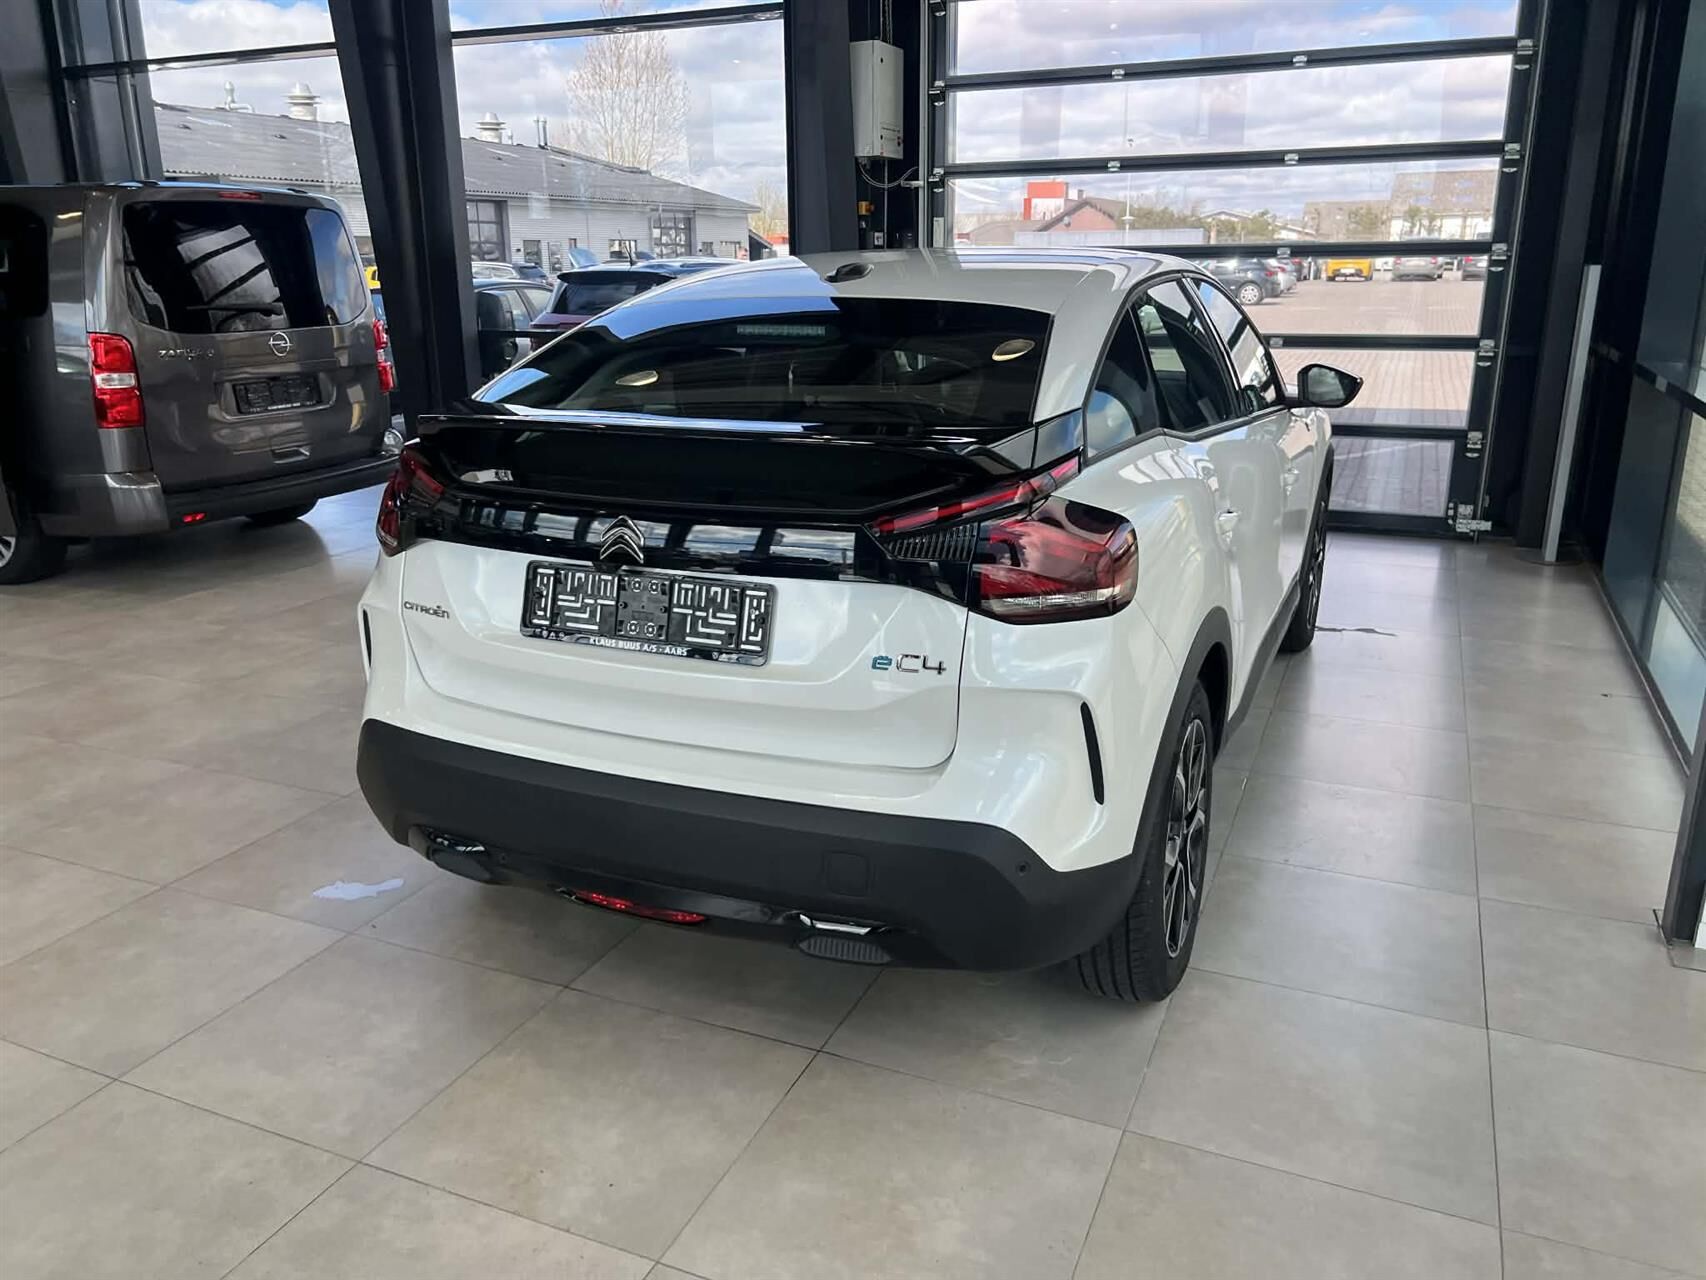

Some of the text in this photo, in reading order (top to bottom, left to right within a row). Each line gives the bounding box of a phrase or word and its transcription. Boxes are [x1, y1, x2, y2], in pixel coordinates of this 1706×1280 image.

[589, 637, 616, 647] KLAUS
[642, 643, 656, 653] A/S
[664, 645, 688, 656] AARS
